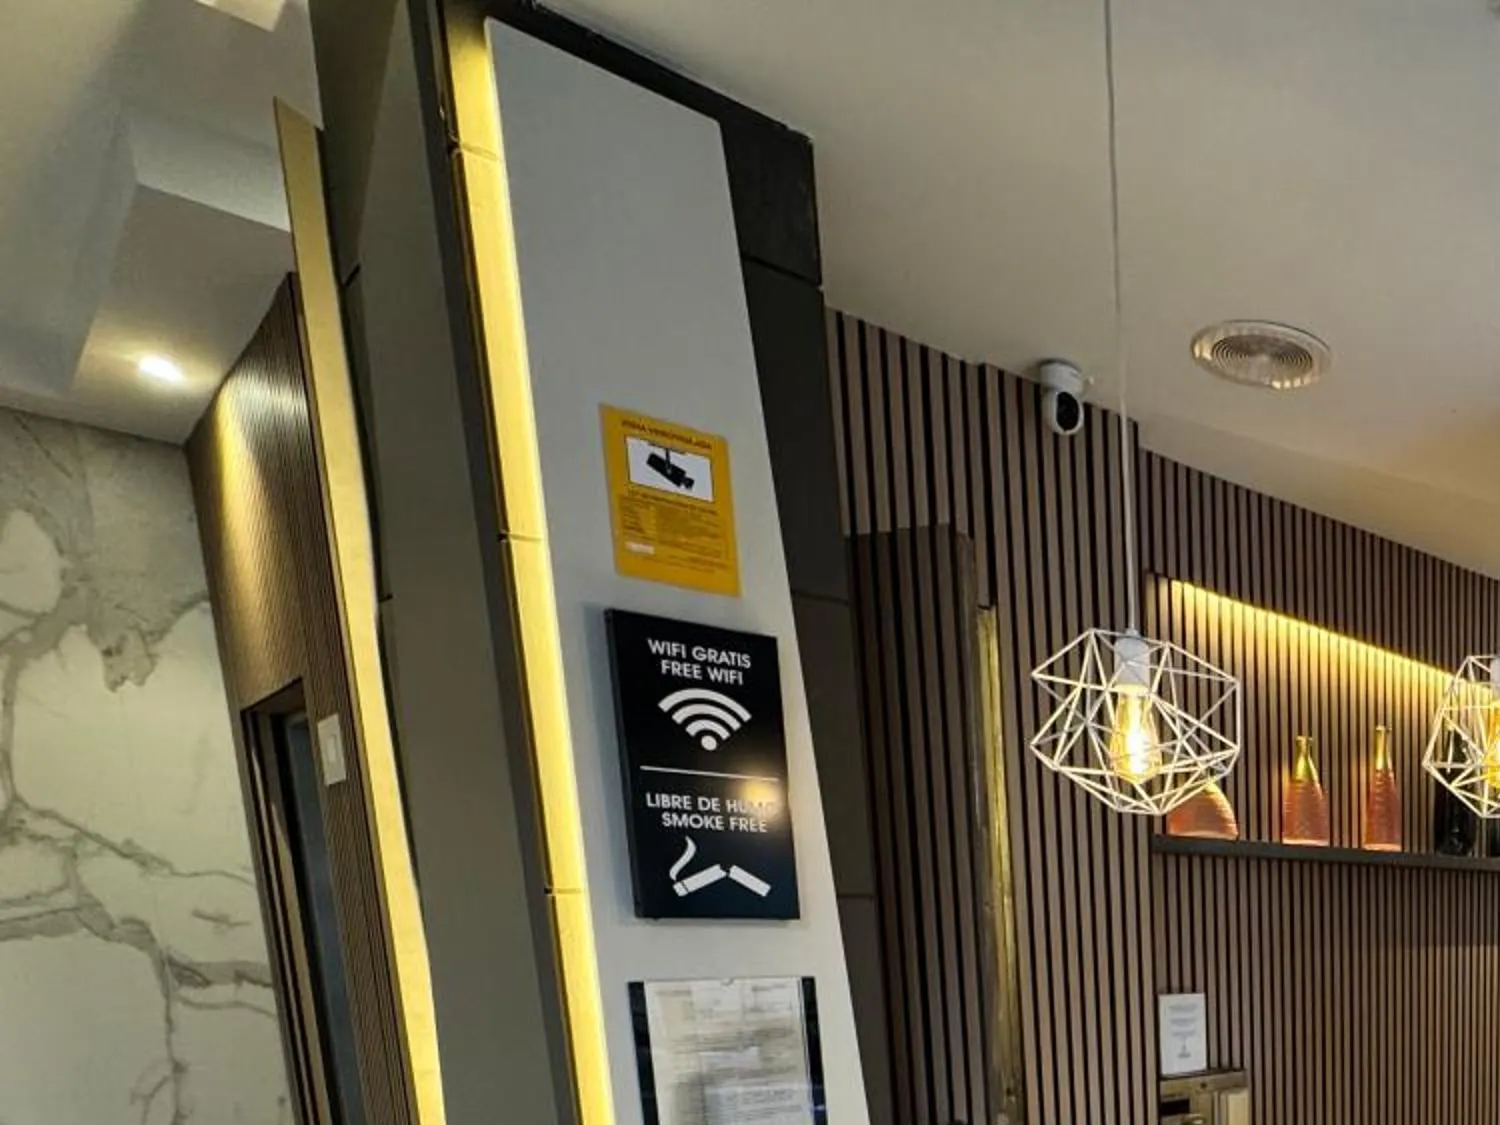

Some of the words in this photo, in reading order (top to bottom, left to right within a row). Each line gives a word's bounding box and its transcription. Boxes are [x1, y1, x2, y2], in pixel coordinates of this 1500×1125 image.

[647, 638, 687, 659] WIFI
[691, 645, 752, 669] GRATIS
[660, 659, 702, 680] FREE
[706, 665, 744, 686] WIFI
[645, 791, 692, 811] LIBRE
[697, 796, 721, 813] DE
[661, 810, 725, 831] SMOKE
[729, 816, 768, 833] FREE
